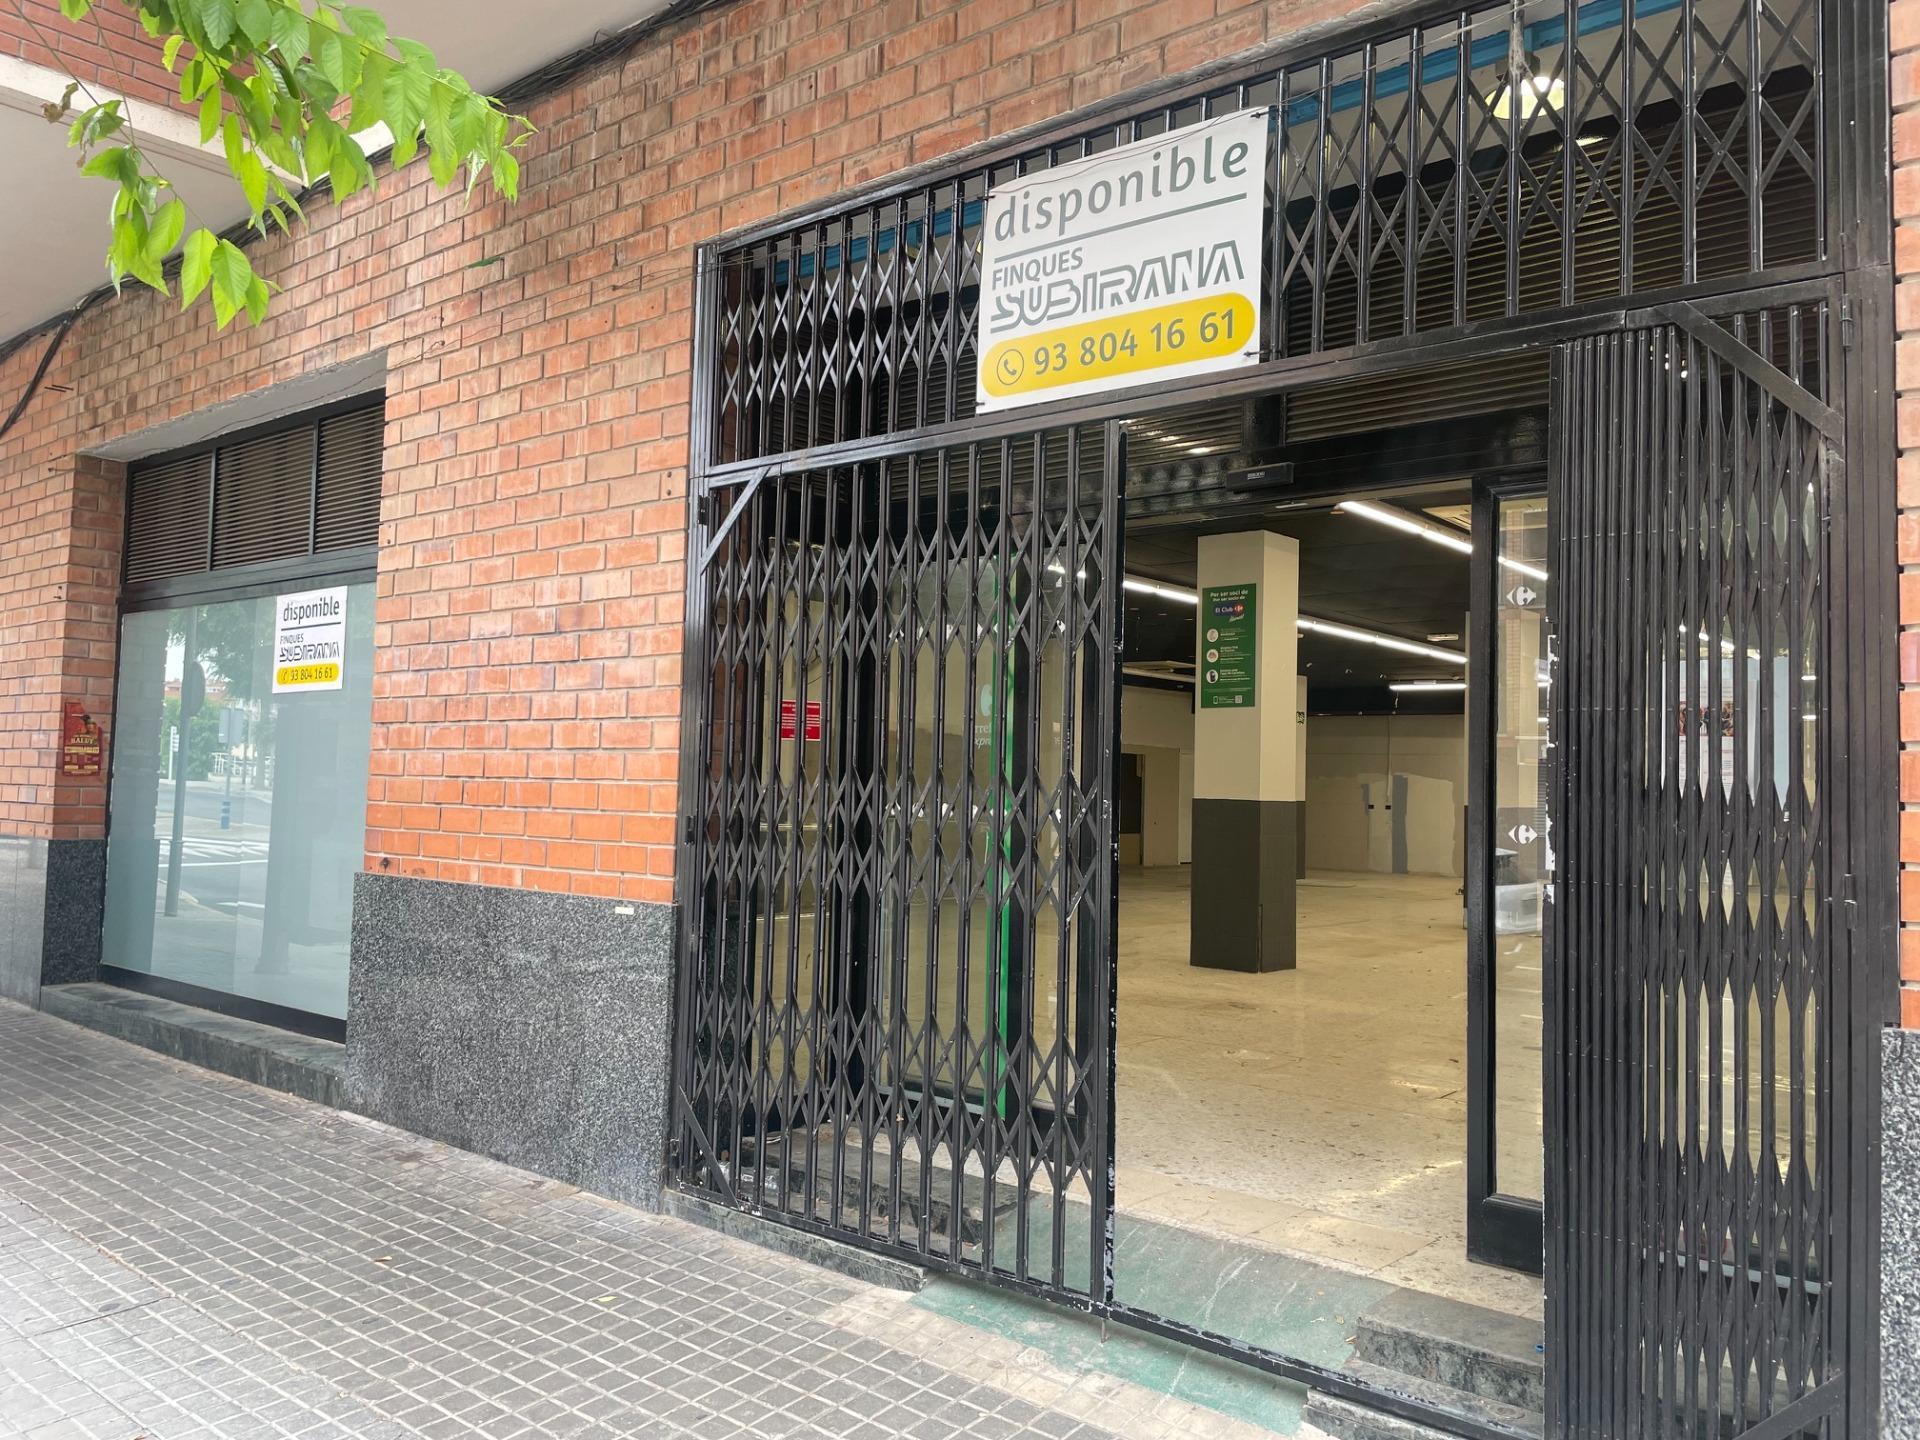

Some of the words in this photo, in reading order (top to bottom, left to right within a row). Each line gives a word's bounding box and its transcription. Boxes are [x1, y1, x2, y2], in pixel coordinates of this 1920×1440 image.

[994, 135, 1249, 242] disponible
[990, 239, 1245, 334] SUBIRANA
[992, 246, 1084, 291] FINQUES
[1033, 342, 1068, 375] 93
[1079, 328, 1138, 367] 804
[1150, 318, 1185, 353] 16
[1199, 308, 1234, 343] 61
[283, 595, 340, 625] disponible
[279, 632, 305, 645] FINQUES
[279, 641, 340, 663] SUBIRANA
[290, 668, 299, 681] 93
[300, 667, 313, 681] 804
[314, 666, 323, 679] 16
[324, 665, 333, 678] 61
